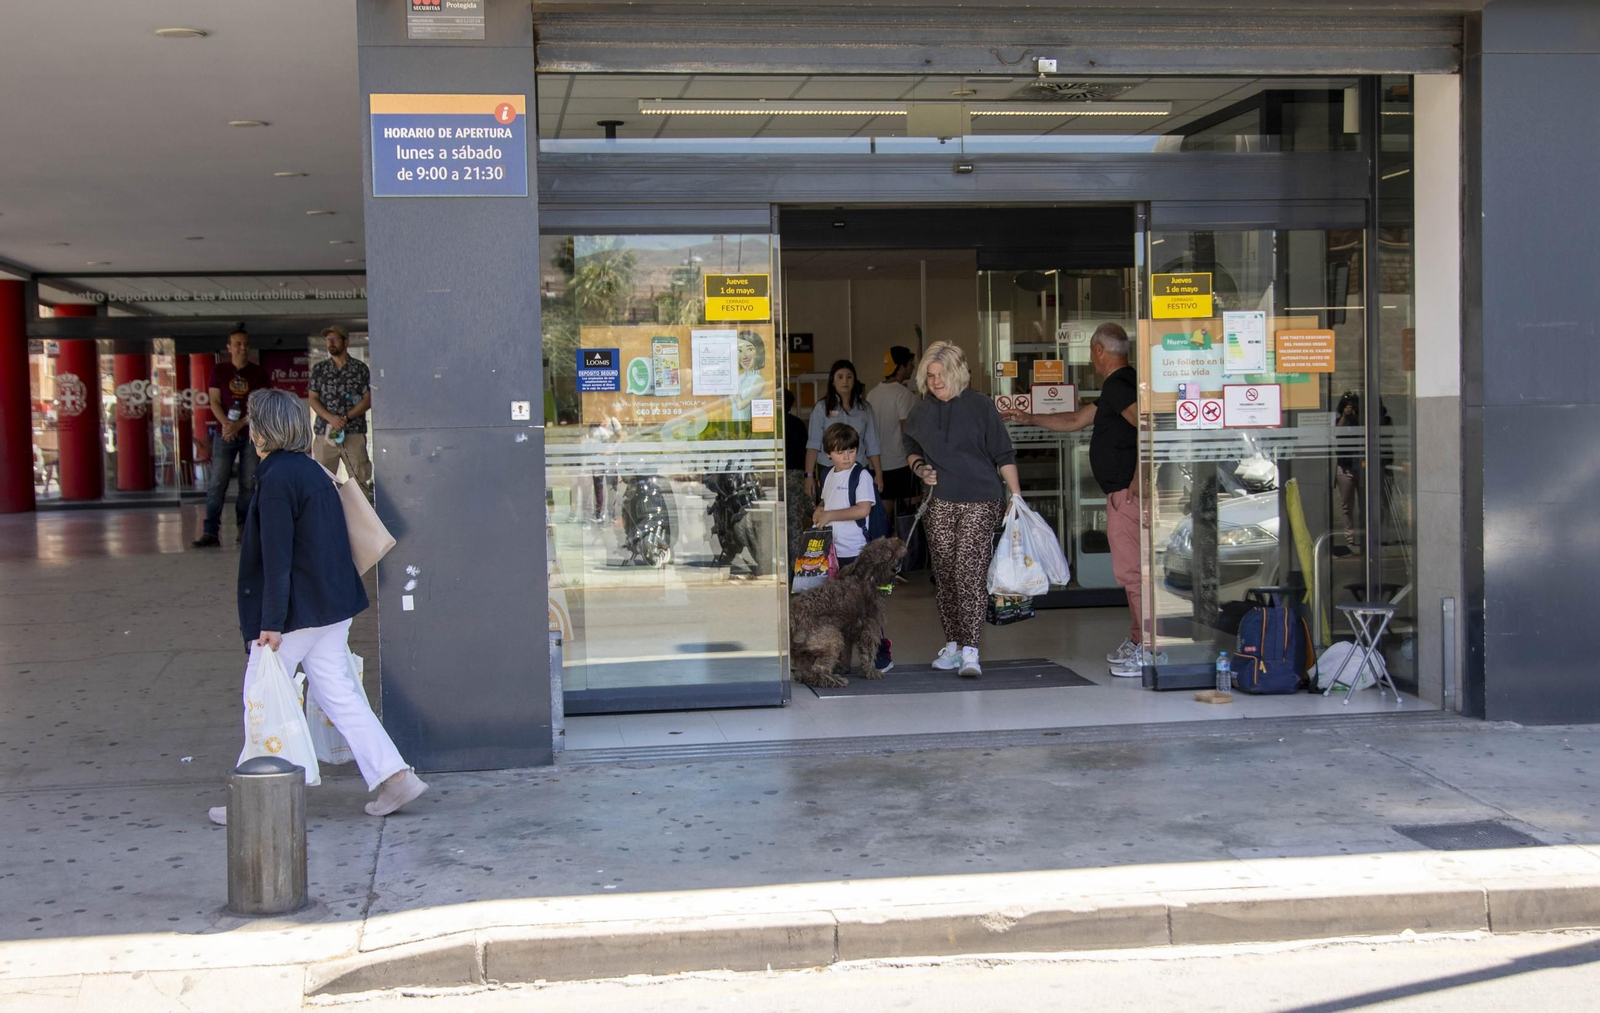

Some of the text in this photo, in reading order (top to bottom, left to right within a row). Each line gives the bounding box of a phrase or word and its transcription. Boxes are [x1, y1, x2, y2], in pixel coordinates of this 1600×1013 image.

[384, 128, 512, 138] HORARIO DE APERTURA
[396, 145, 502, 159] lunes a sábado
[397, 166, 503, 180] de 9:00 a 21:30
[108, 290, 169, 303] Deportivo
[174, 290, 190, 301] de
[194, 290, 215, 300] Las
[218, 288, 305, 300] Almadrabillas
[794, 337, 802, 350] P
[289, 368, 298, 378] lo
[116, 380, 159, 404] ego
